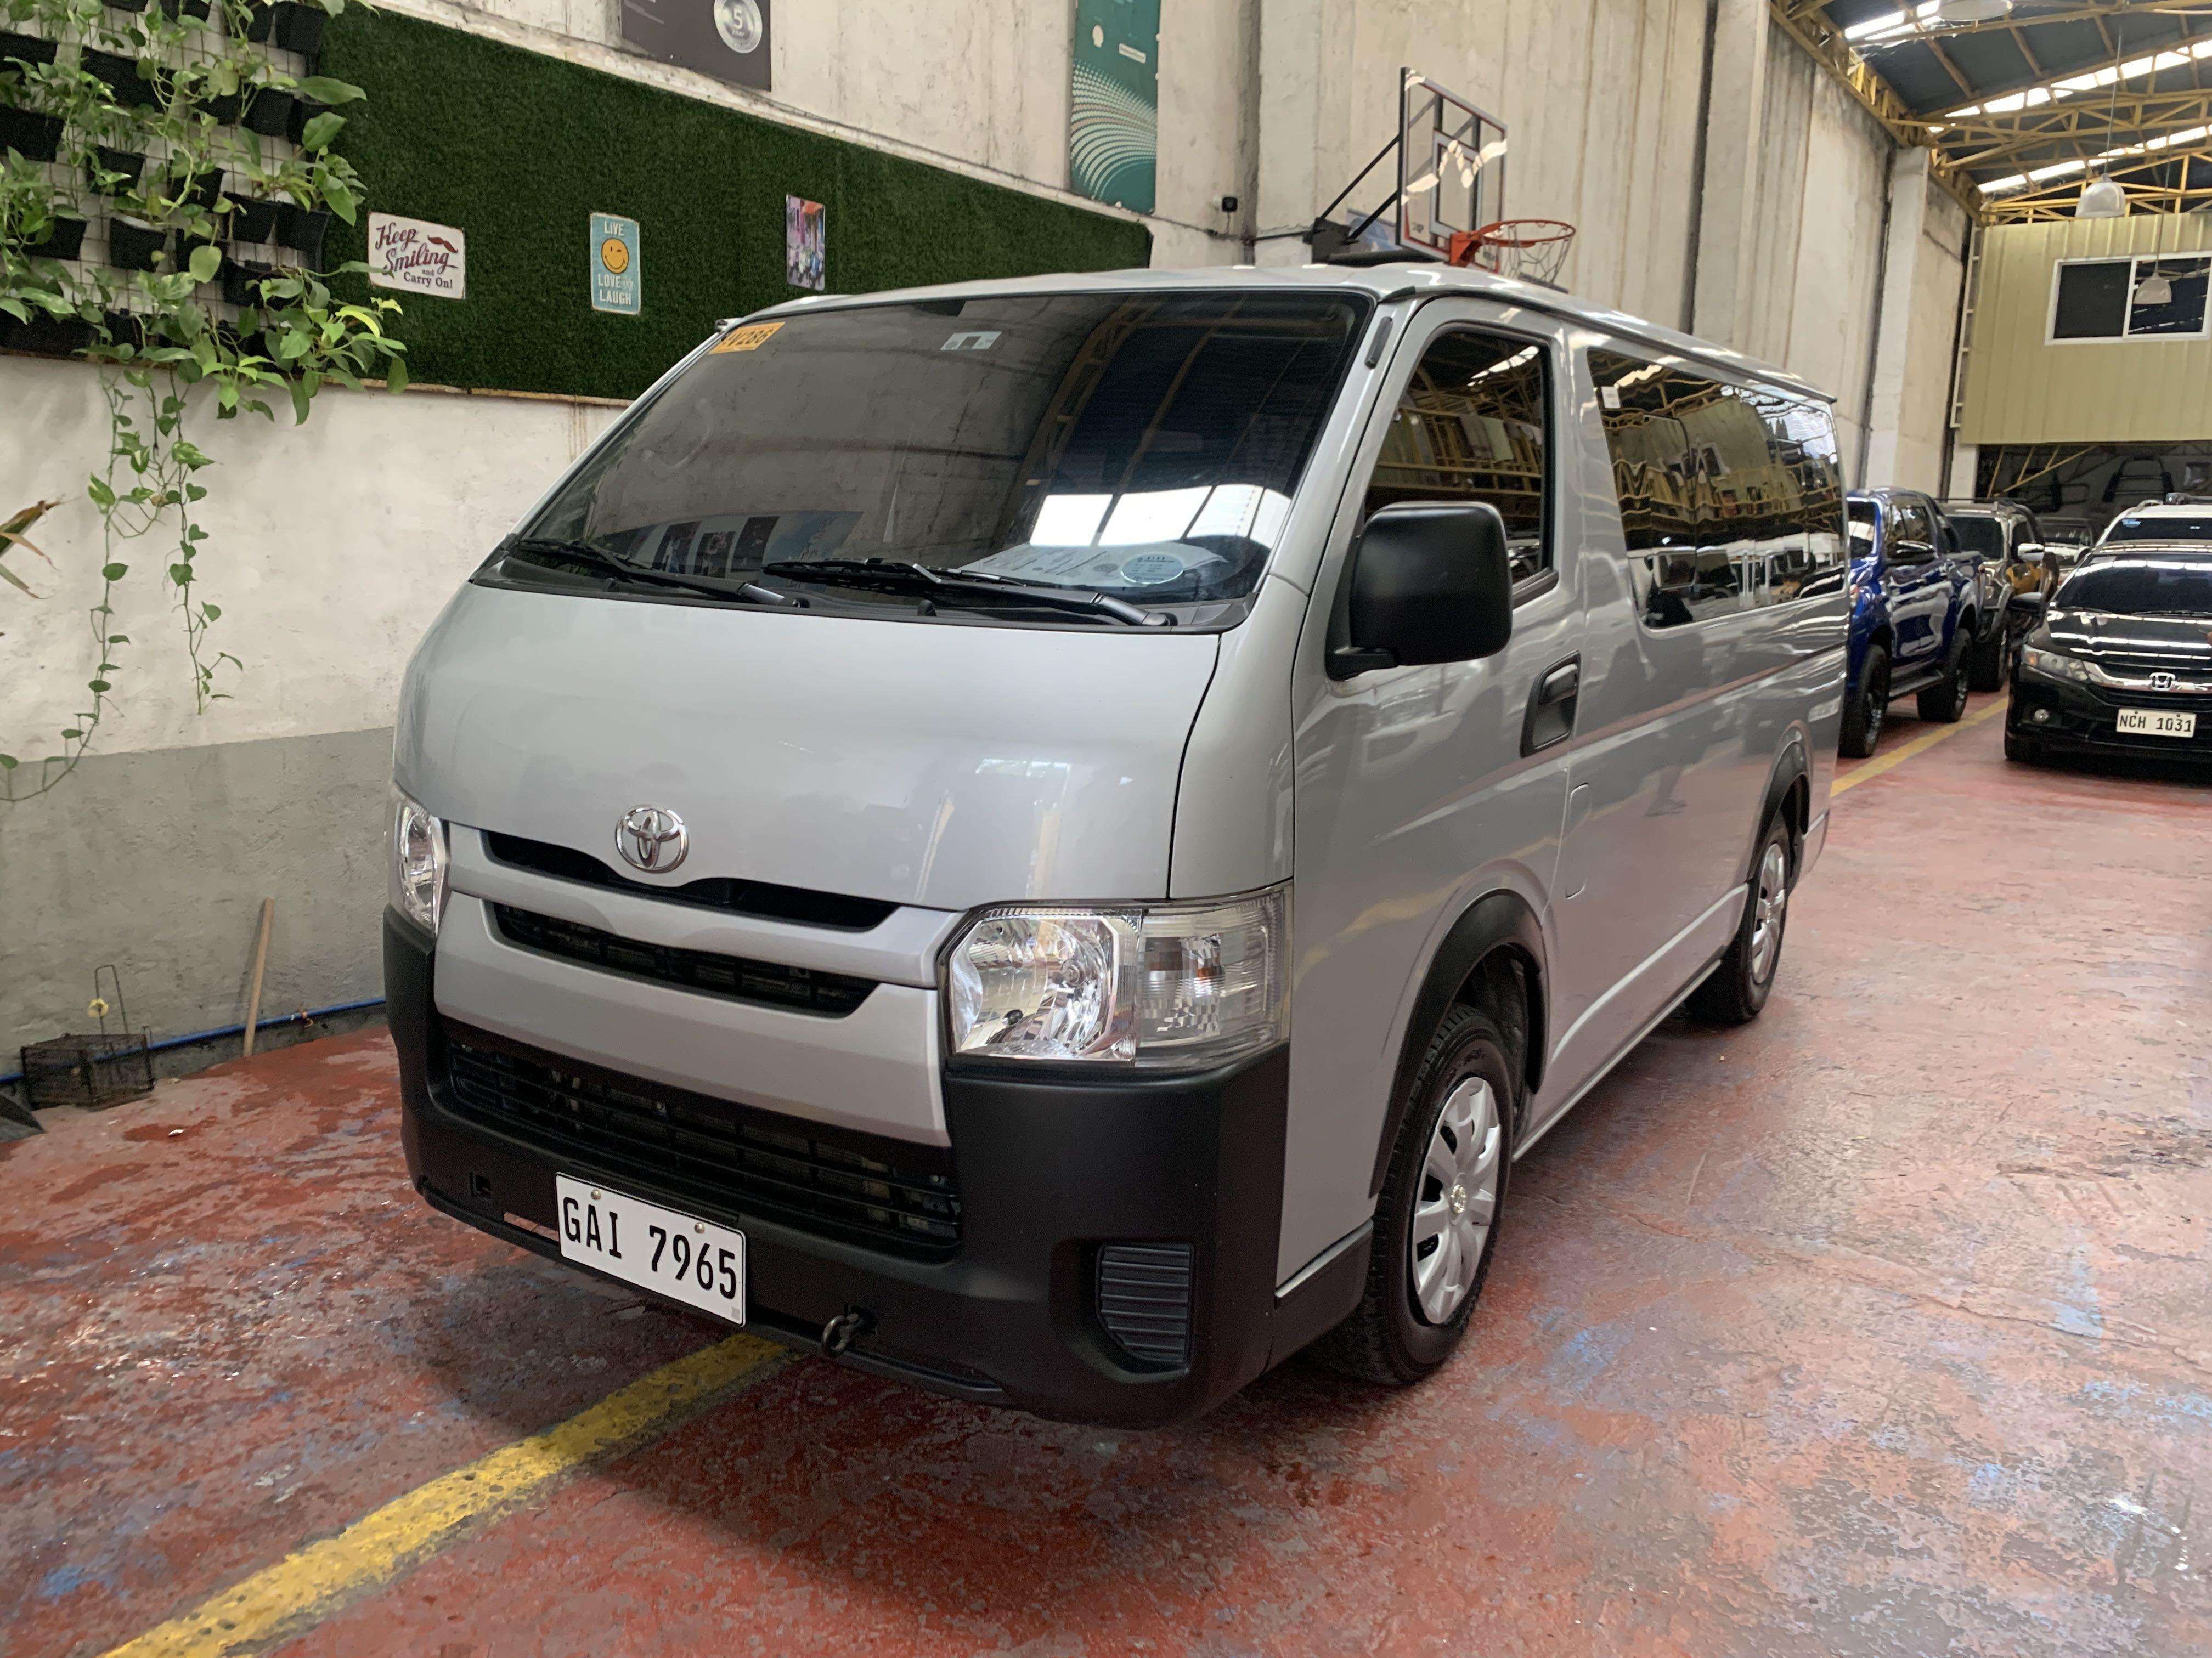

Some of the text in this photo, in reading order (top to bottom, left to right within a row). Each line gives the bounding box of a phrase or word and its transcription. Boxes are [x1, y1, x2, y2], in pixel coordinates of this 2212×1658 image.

[733, 8, 743, 29] 5
[375, 222, 420, 251] Keep
[605, 221, 624, 236] LIVE
[382, 242, 458, 275] Smiling
[404, 271, 453, 288] Carry On!
[598, 274, 621, 288] LOVE
[600, 289, 631, 305] LAUGH
[2120, 715, 2192, 732] NCH 1031
[563, 1197, 736, 1299] GAI 7965
